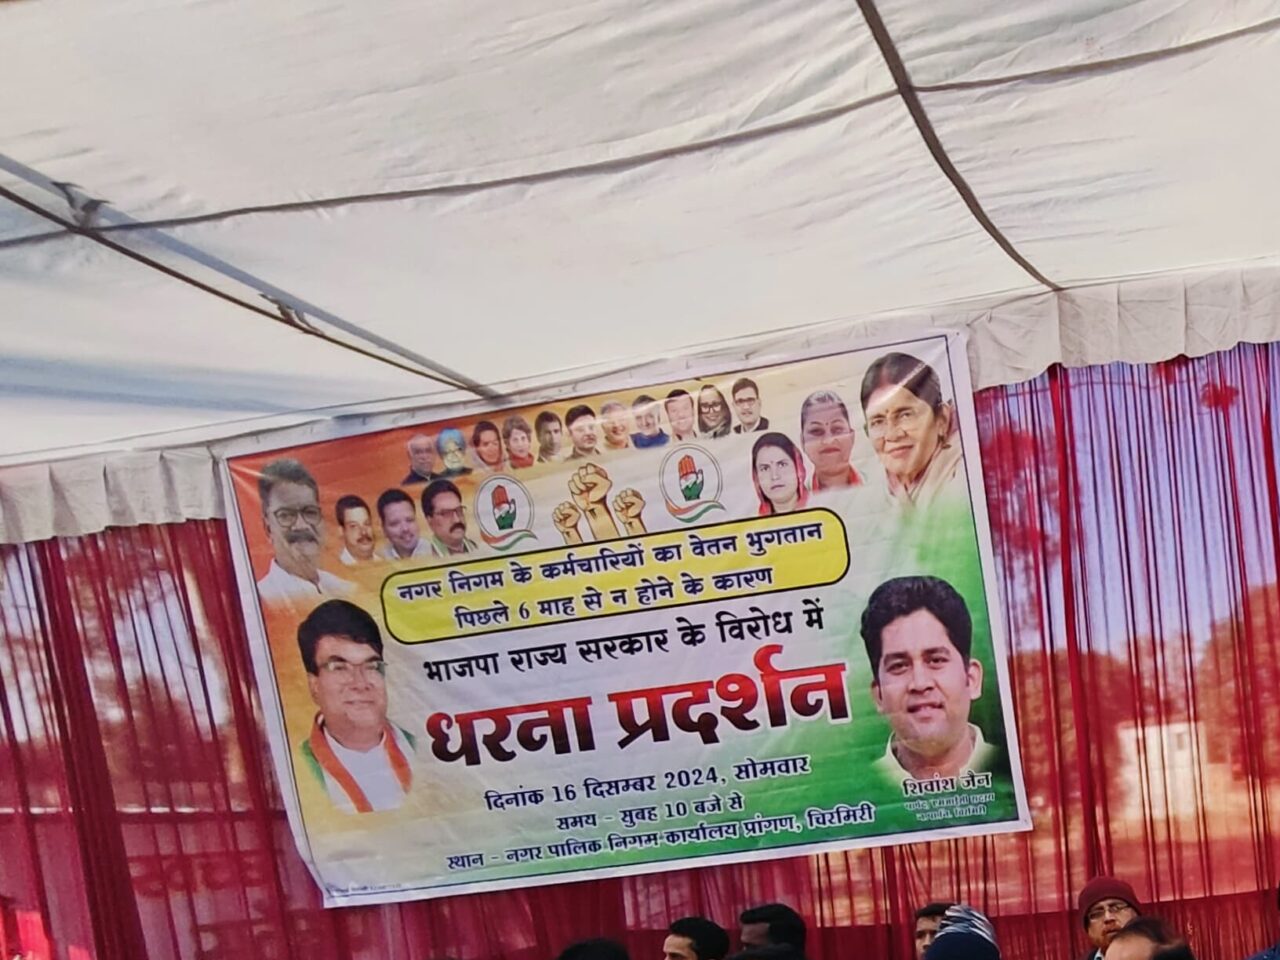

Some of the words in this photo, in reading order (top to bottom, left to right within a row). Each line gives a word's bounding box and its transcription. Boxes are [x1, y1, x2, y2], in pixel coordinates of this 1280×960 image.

[398, 581, 443, 601] नगर
[448, 571, 505, 594] निगम
[509, 561, 533, 585] के
[539, 542, 645, 581] कर्मचारियों
[653, 544, 683, 563] का
[692, 529, 738, 559] वेतन
[747, 522, 823, 558] भुगतान
[453, 597, 510, 630] पिछले
[518, 601, 531, 622] 6
[539, 594, 576, 618] माह
[582, 583, 603, 609] से
[611, 587, 628, 606] न
[637, 572, 675, 607] होने
[683, 572, 705, 596] के
[714, 566, 774, 592] कारण
[423, 651, 501, 683] भाजपा
[508, 642, 567, 671] राज्य
[576, 632, 669, 663] सरकार
[676, 616, 707, 647] के
[715, 608, 794, 644] विरोध
[802, 598, 825, 631] में
[425, 696, 597, 767] धरना
[608, 645, 851, 751] प्रदर्शन
[484, 783, 545, 813] दिनांक
[552, 783, 578, 805] 16
[583, 770, 655, 803] दिसम्बर
[664, 764, 727, 791] 2024,
[733, 755, 812, 782] सोमवार
[556, 812, 598, 832] समय
[620, 806, 659, 828] सुबह
[665, 801, 687, 818] 10
[693, 795, 724, 815] बजे
[727, 794, 744, 811] से
[903, 773, 955, 796] शिवांश
[960, 770, 992, 788] जैन
[446, 851, 485, 871] स्थान
[506, 846, 544, 863] नगर
[547, 835, 604, 857] पालिक
[607, 829, 662, 852] निगम
[664, 822, 739, 848] कार्यालय
[743, 813, 801, 840] प्रांगण,
[806, 803, 874, 828] चिरमिरी
